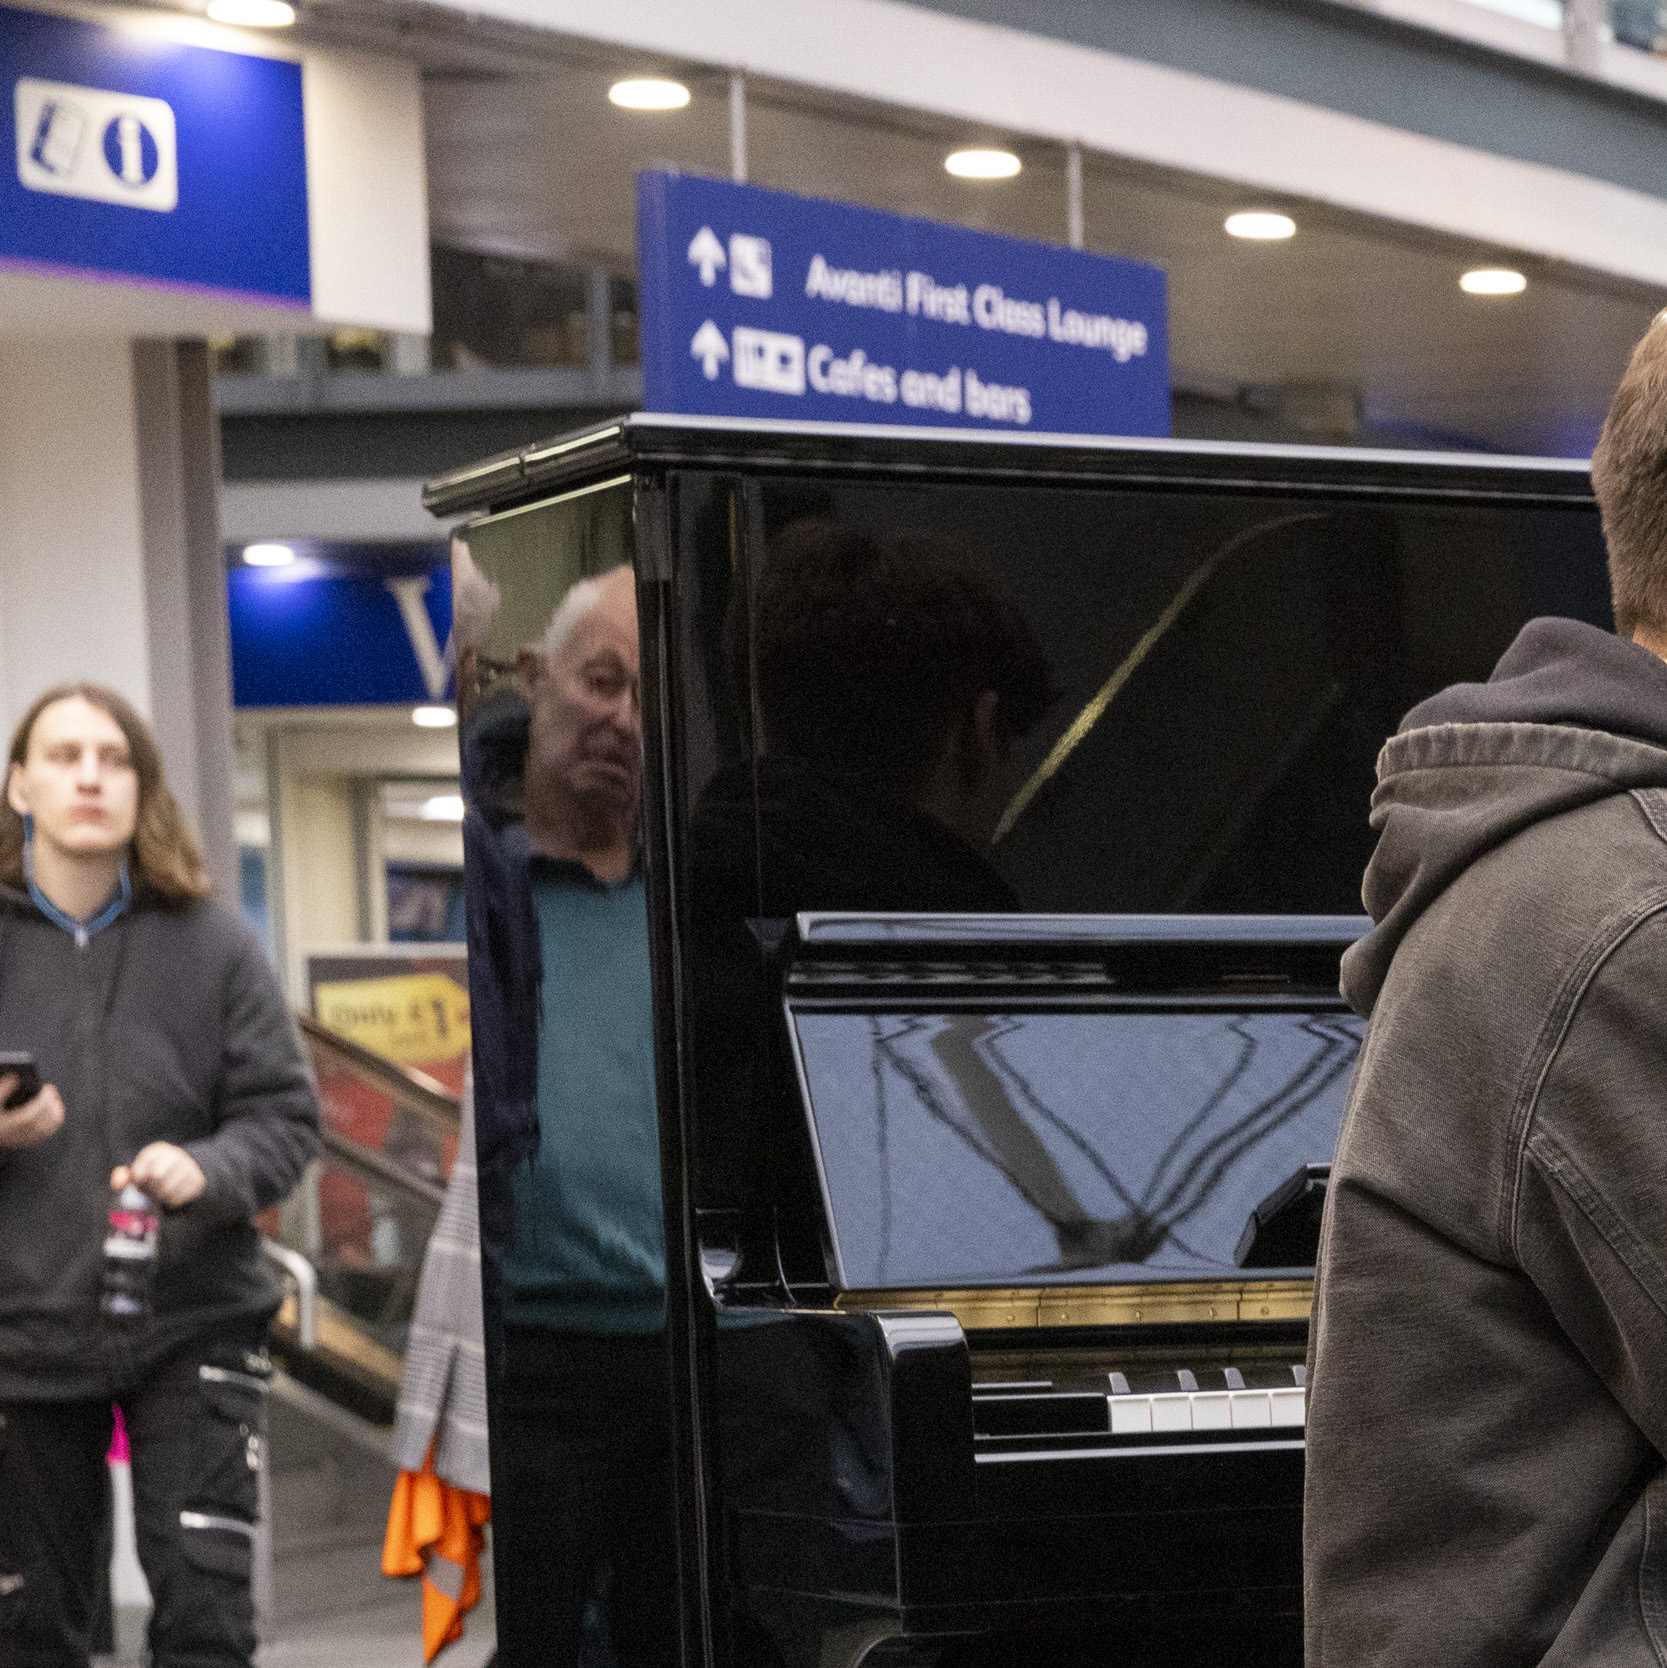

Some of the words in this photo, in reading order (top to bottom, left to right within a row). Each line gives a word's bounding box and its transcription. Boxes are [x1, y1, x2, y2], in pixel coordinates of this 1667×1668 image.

[804, 252, 902, 313] Avanti
[904, 270, 972, 325] First
[972, 284, 1047, 337] Class
[1048, 297, 1148, 363] Lounge
[807, 343, 898, 402] Cafes
[900, 365, 962, 413] and
[964, 369, 1032, 424] bars
